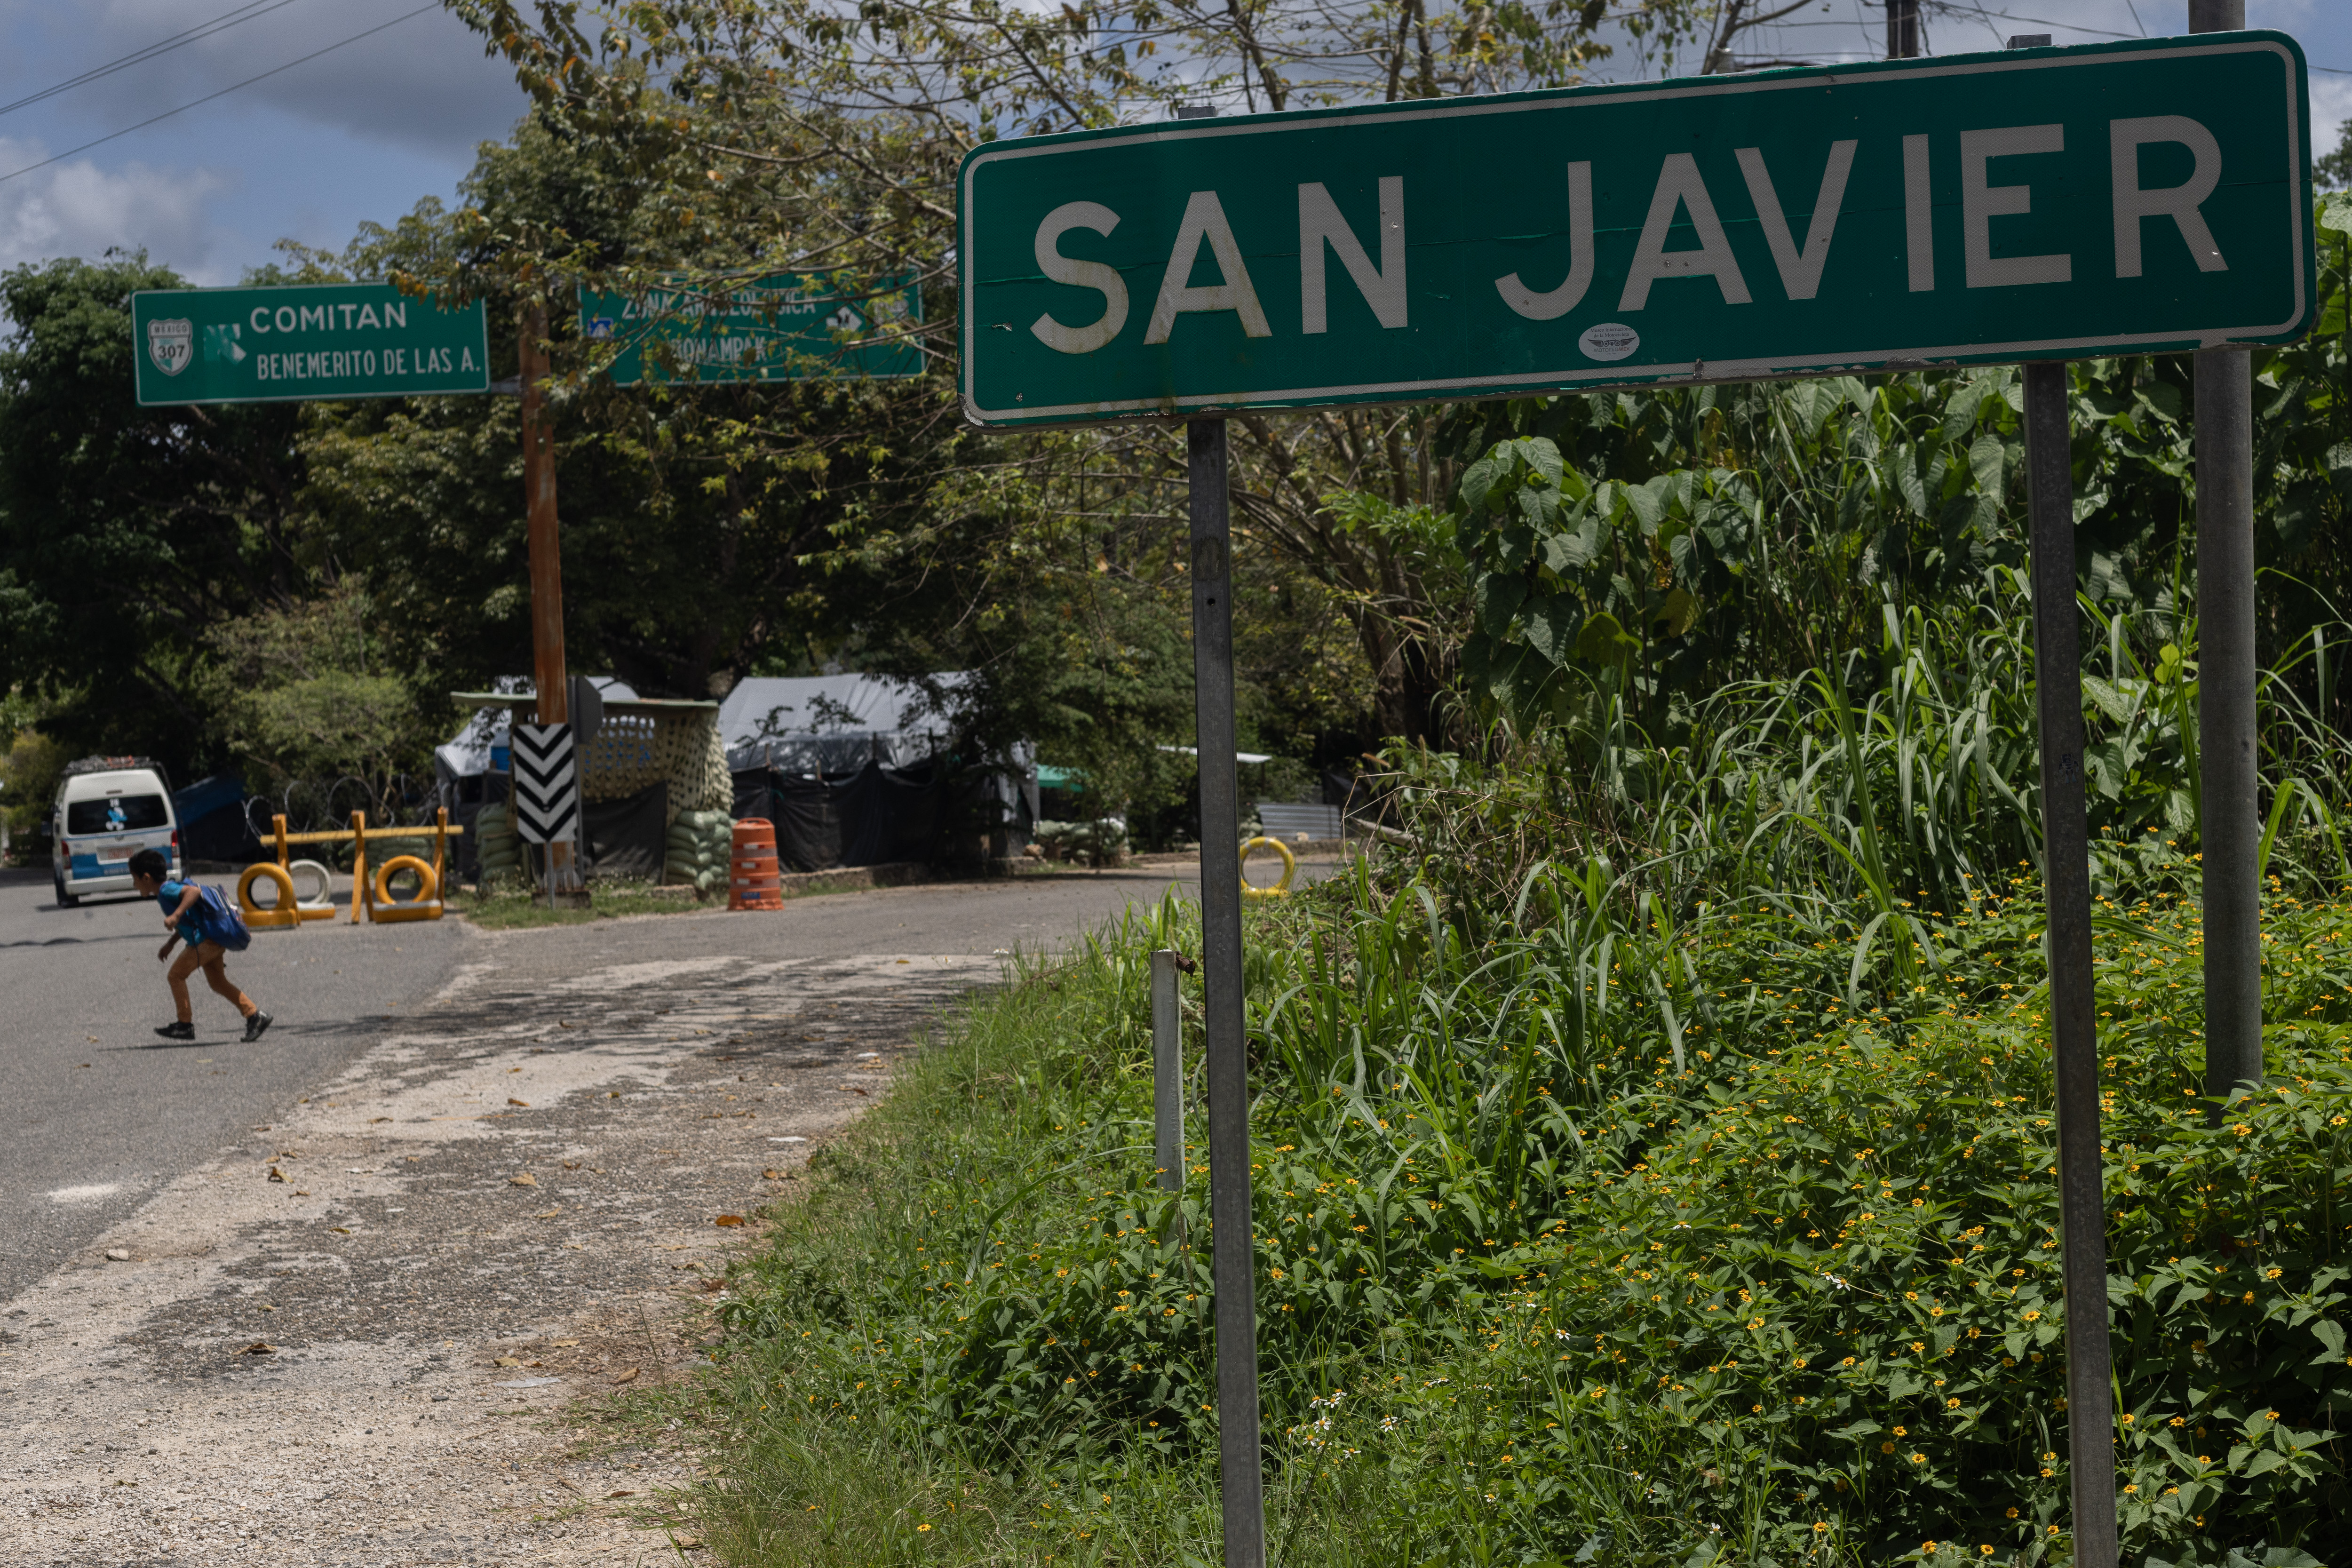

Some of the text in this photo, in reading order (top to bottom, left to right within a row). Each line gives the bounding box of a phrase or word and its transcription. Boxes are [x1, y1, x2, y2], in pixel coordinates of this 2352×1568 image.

[1029, 114, 2229, 355] SAN JAVIER
[154, 323, 187, 334] MEXICO
[250, 302, 406, 333] COMITAN
[158, 344, 184, 358] 307
[257, 346, 481, 380] BENEMERITO DE LAS A.
